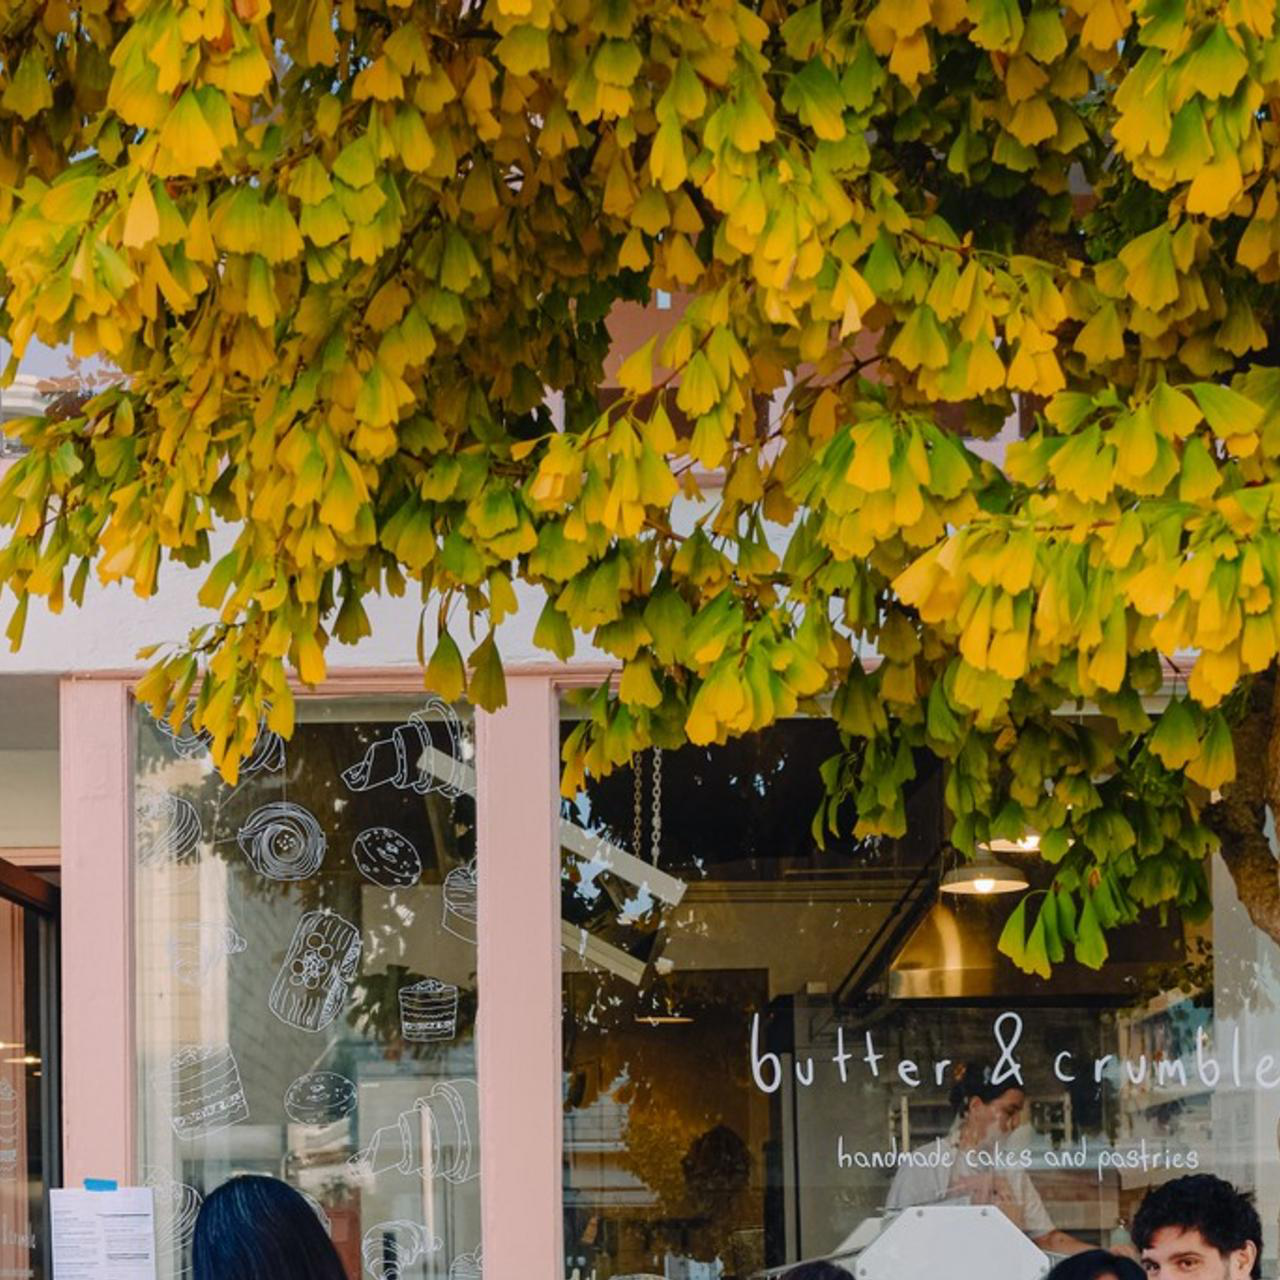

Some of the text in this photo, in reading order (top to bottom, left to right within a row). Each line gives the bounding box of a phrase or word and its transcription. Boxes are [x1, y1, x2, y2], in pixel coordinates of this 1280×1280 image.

[751, 1012, 951, 1093] butter
[990, 1012, 1024, 1086] &
[837, 1135, 1200, 1183] handmade cakes and pastries
